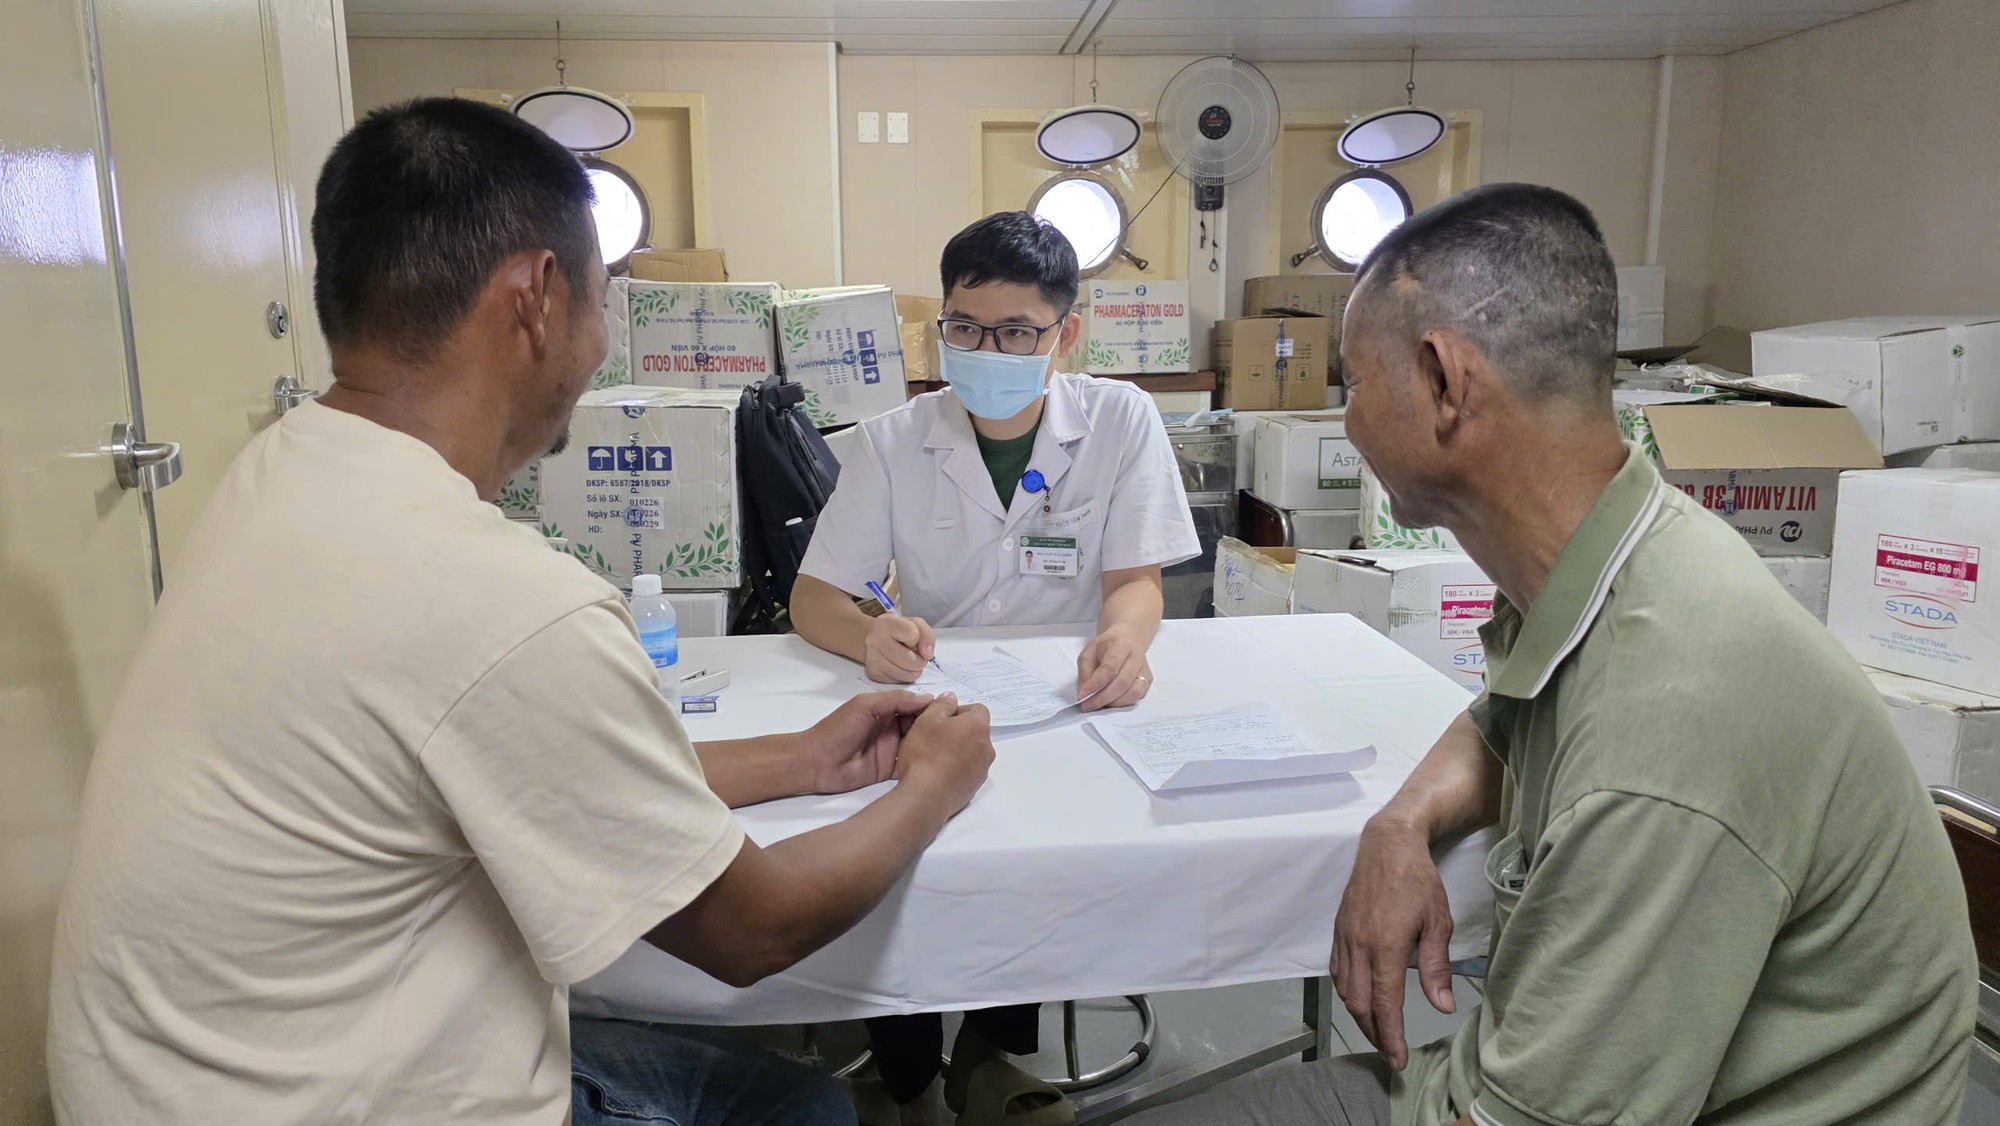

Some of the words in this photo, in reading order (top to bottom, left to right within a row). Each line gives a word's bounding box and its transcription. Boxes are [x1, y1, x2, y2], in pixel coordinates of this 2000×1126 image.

[1163, 304, 1184, 317] GOLD
[643, 355, 671, 372] GOLD
[1734, 485, 1816, 511] VITAMIN
[1760, 526, 1772, 535] PV
[1886, 555, 1922, 570] Piracetam
[1924, 561, 1936, 571] EG
[1937, 563, 1951, 574] 800
[1885, 600, 1958, 624] STADA
